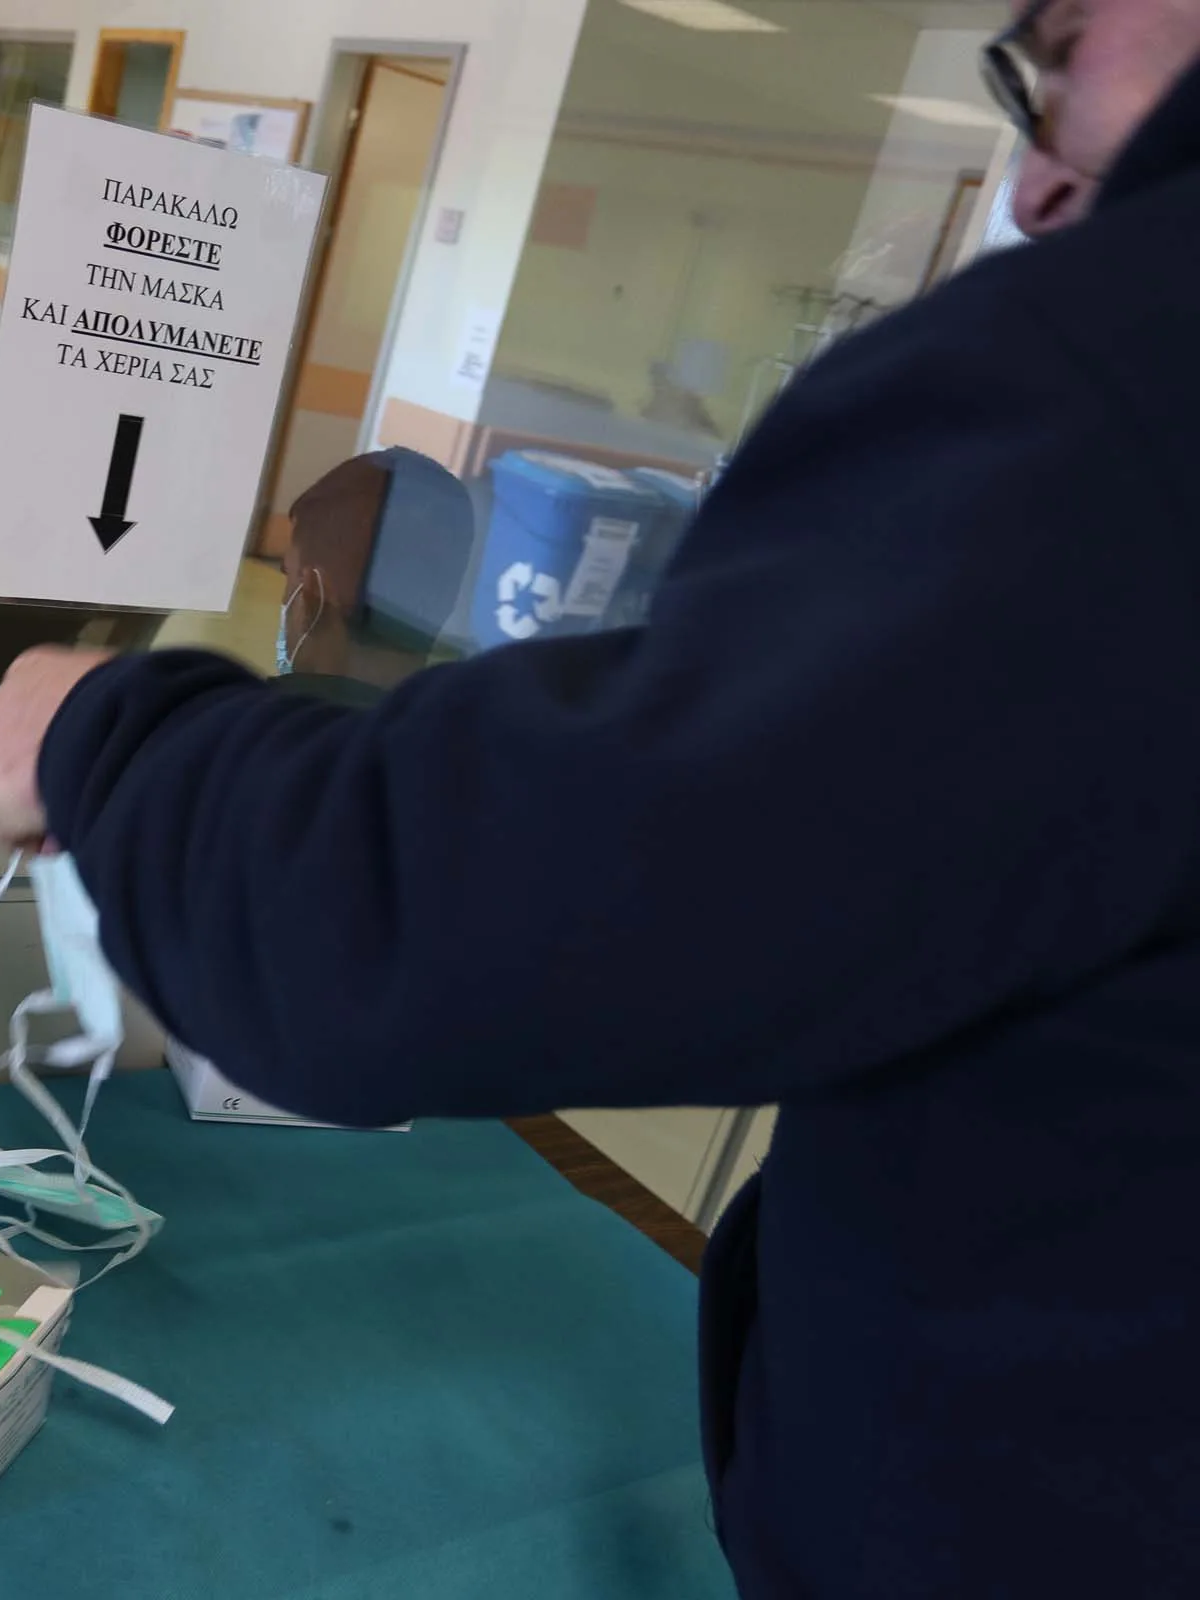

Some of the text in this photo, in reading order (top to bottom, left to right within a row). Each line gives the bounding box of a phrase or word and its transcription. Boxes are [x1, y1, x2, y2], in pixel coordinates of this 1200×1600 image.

[101, 178, 238, 229] ΠΑΡΑΚΑΛΩ
[105, 221, 222, 266] ΦΟΡΕΣΤΕ
[87, 263, 225, 310] ΤΗΝ ΜΑΣΚΑ
[21, 297, 263, 361] ΚΑΙ ΑΠΟΛΥΜΑΝΕΤΕ
[57, 344, 215, 389] ΤΑ ΧΕΡΙΑ ΣΑΣ
